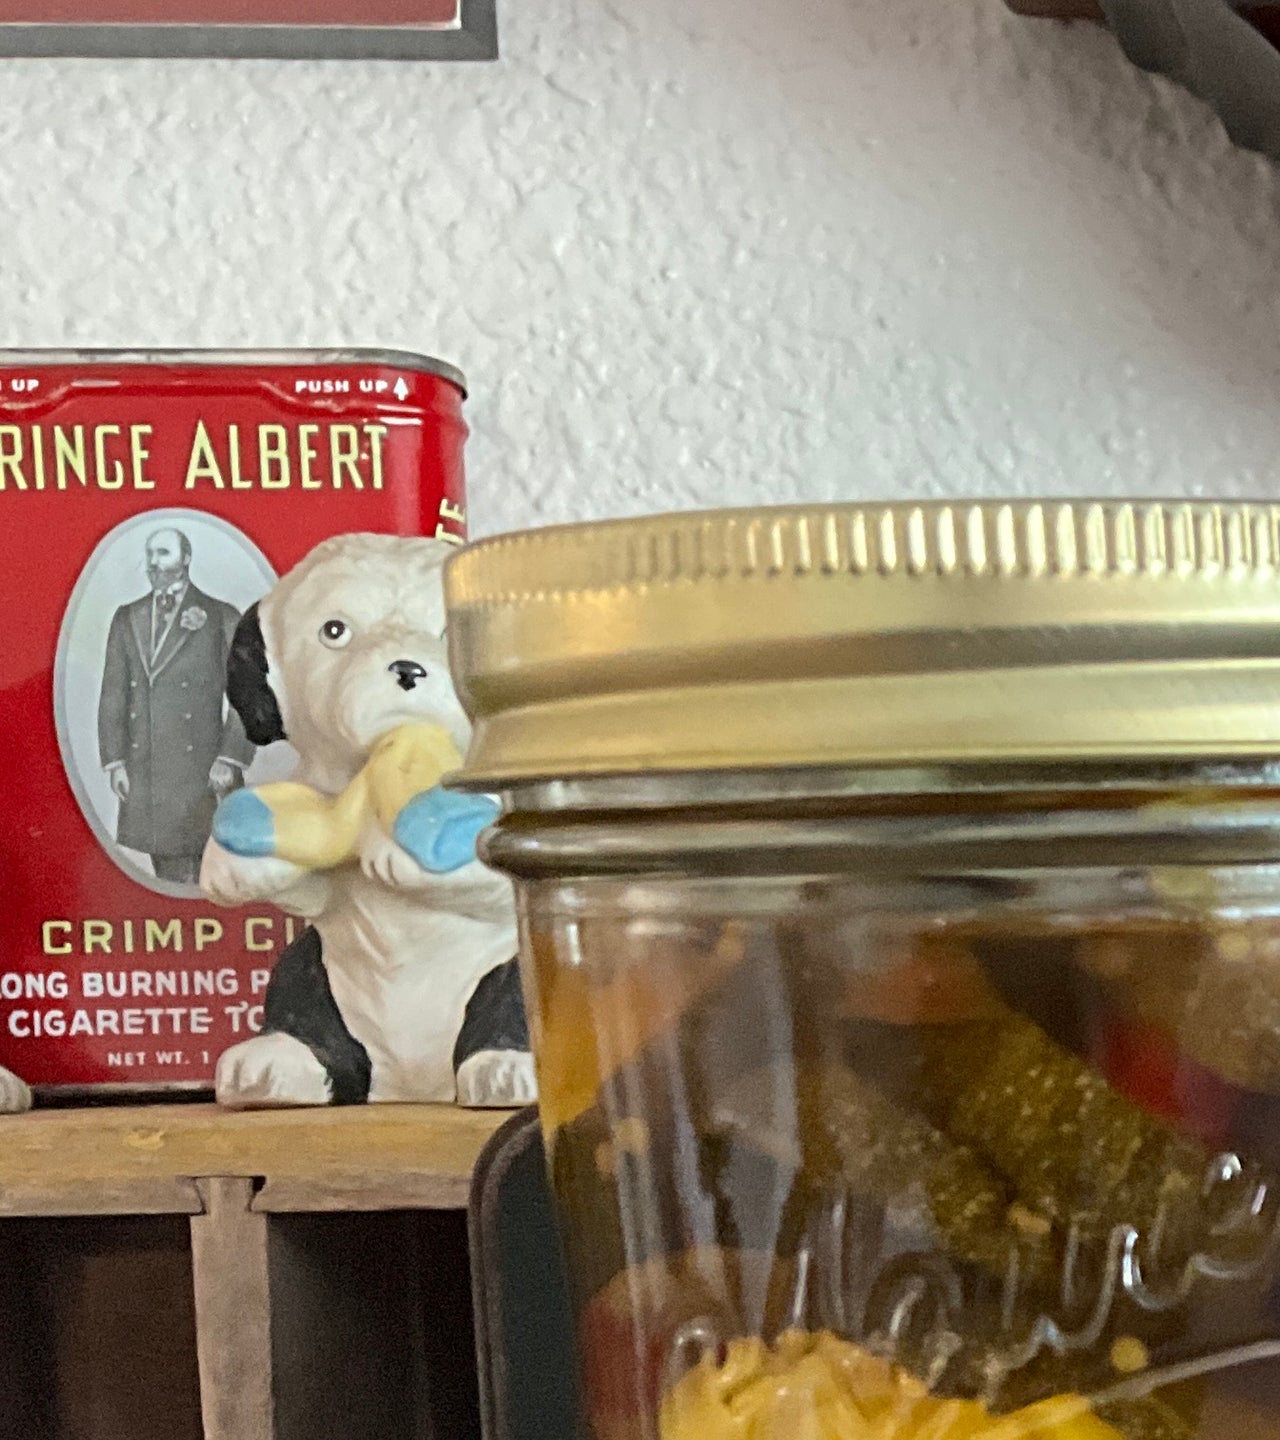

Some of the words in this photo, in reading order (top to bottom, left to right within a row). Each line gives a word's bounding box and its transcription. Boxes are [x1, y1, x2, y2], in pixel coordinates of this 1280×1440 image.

[11, 379, 39, 392] UP
[295, 379, 349, 394] PUSH
[359, 380, 388, 393] UP
[0, 424, 156, 490] RINCE
[185, 419, 388, 490] ALBERT
[42, 917, 223, 955] CRIMP
[0, 971, 68, 999] ONG
[82, 968, 239, 998] BURNING
[8, 1006, 213, 1038] CIGARETTE
[108, 1052, 146, 1067] NET
[155, 1050, 191, 1066] WT.
